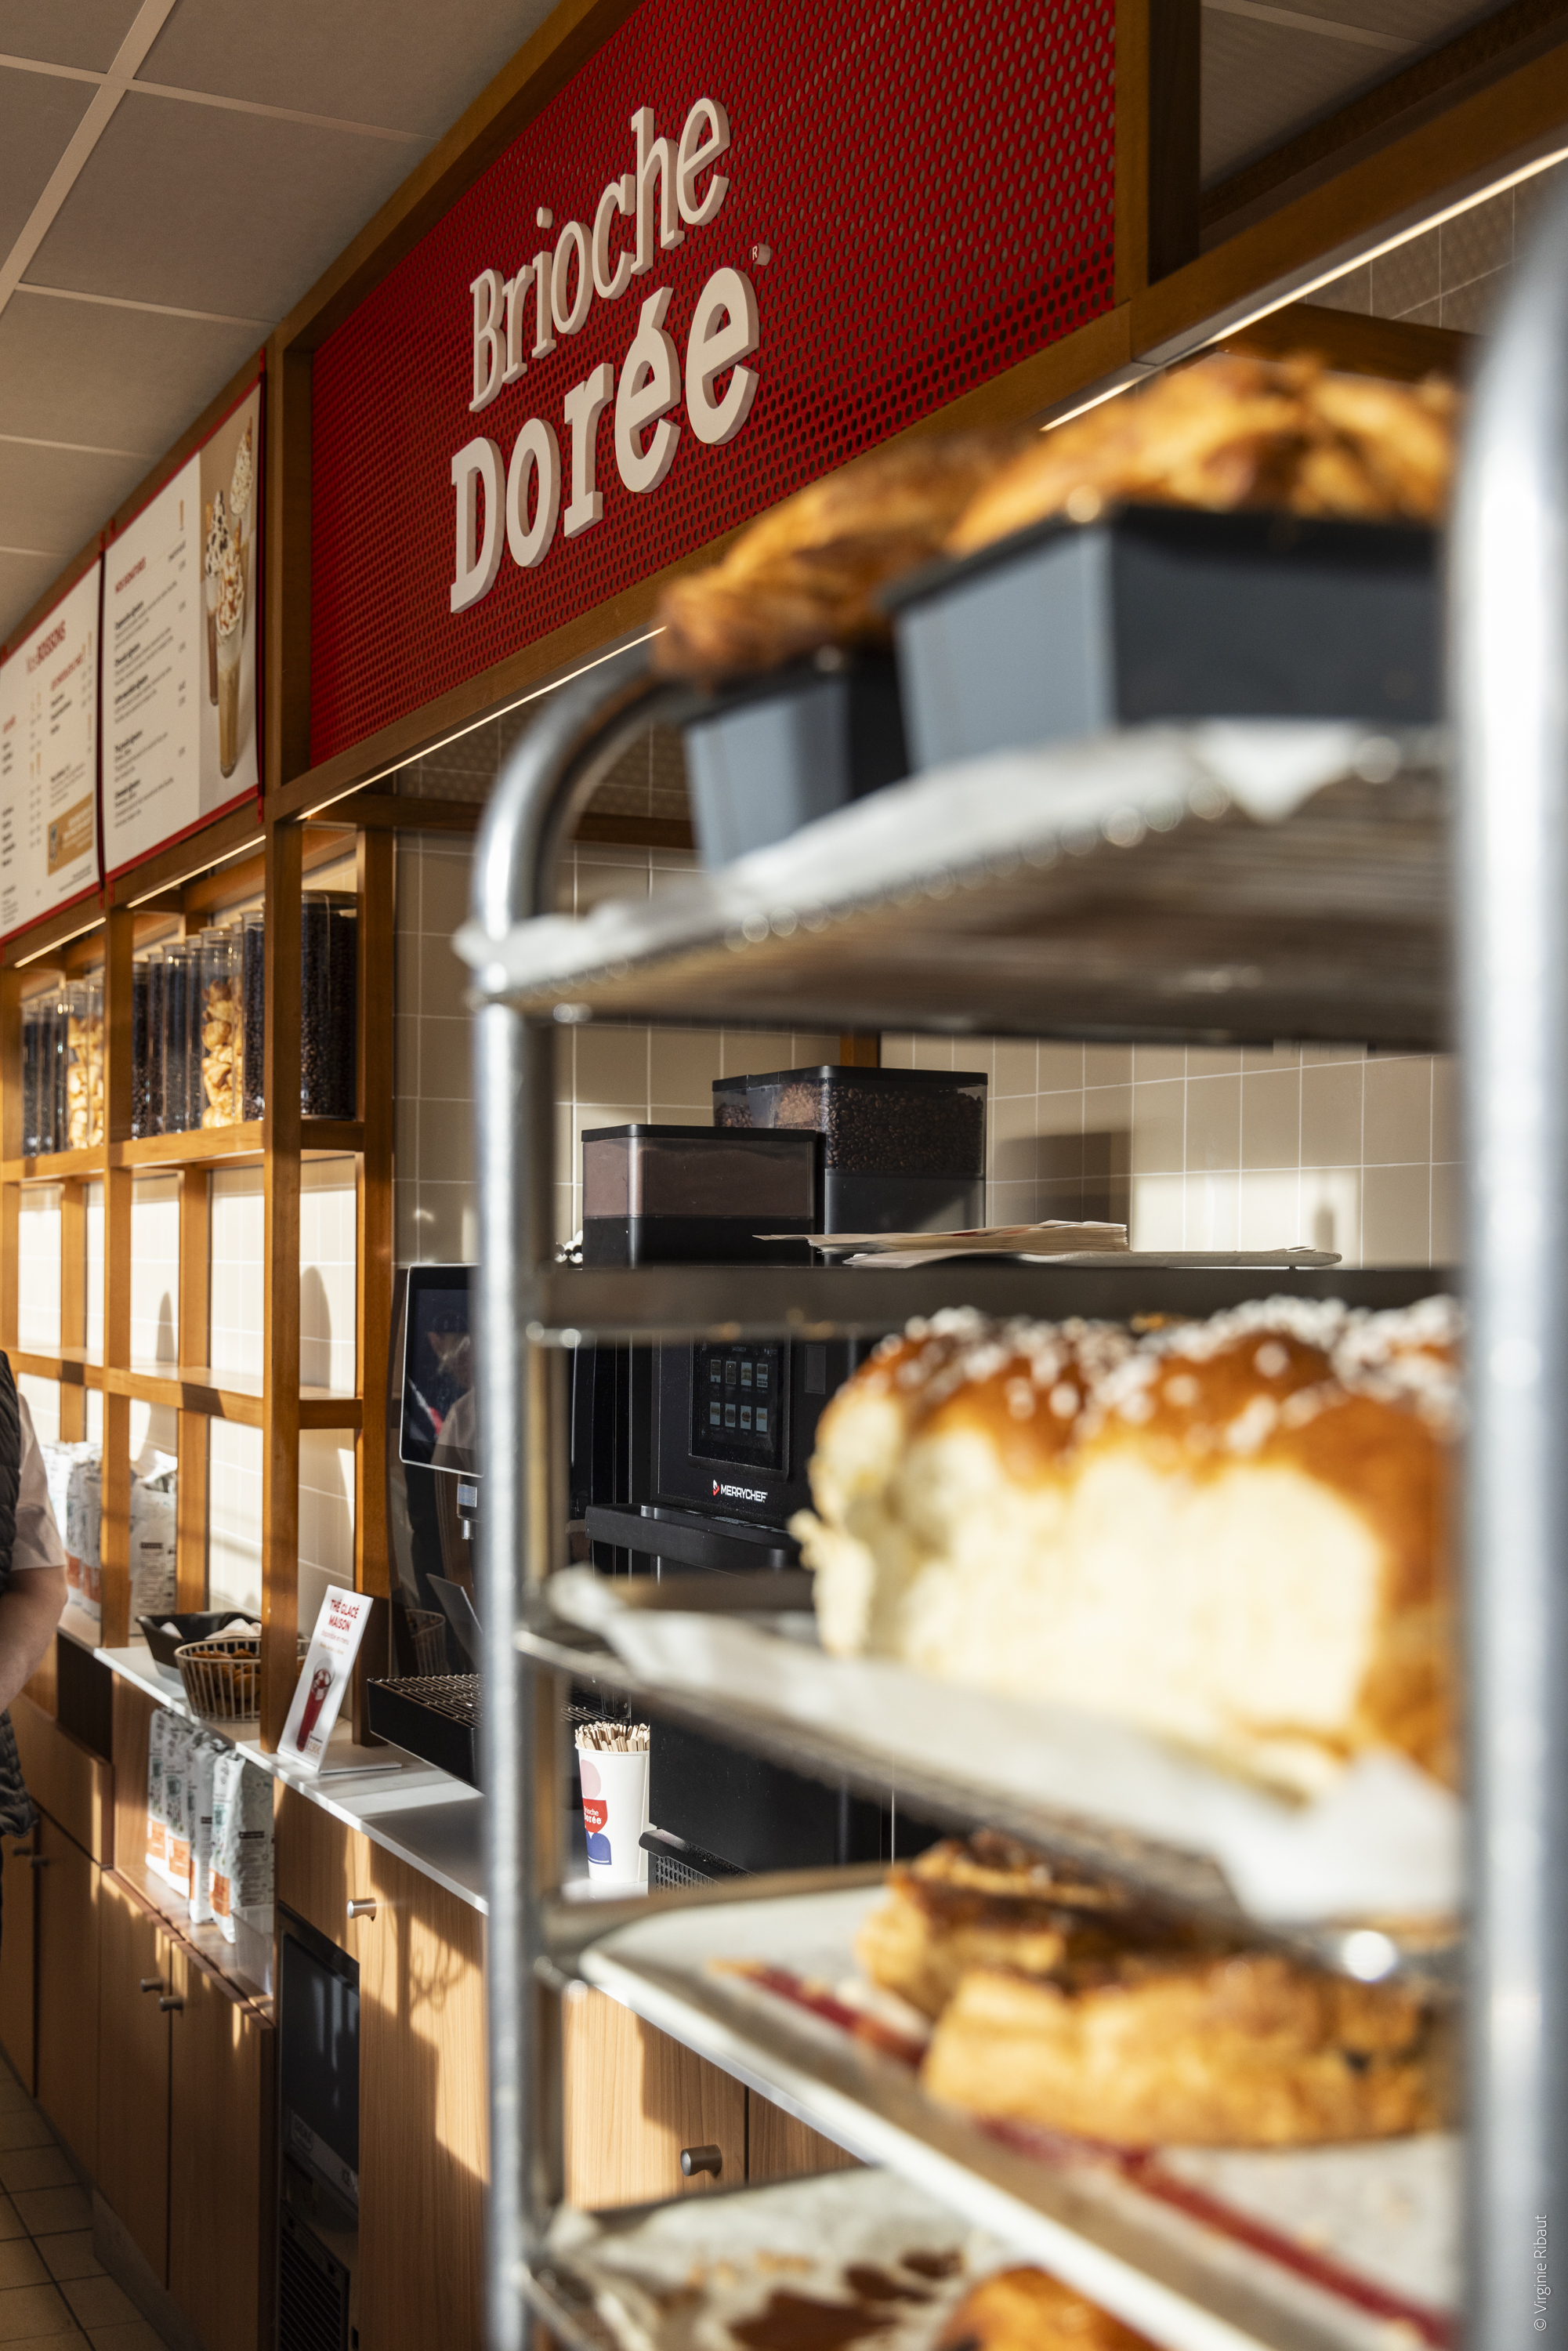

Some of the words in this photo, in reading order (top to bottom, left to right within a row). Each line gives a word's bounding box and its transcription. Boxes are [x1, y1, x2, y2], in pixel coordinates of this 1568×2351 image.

[469, 98, 730, 412] Brioche
[451, 267, 759, 614] Dorée
[720, 1483, 766, 1502] MERRYCHEF
[330, 1599, 342, 1613] THÉ
[341, 1603, 360, 1619] GLACÉ
[328, 1614, 352, 1632] MAISON
